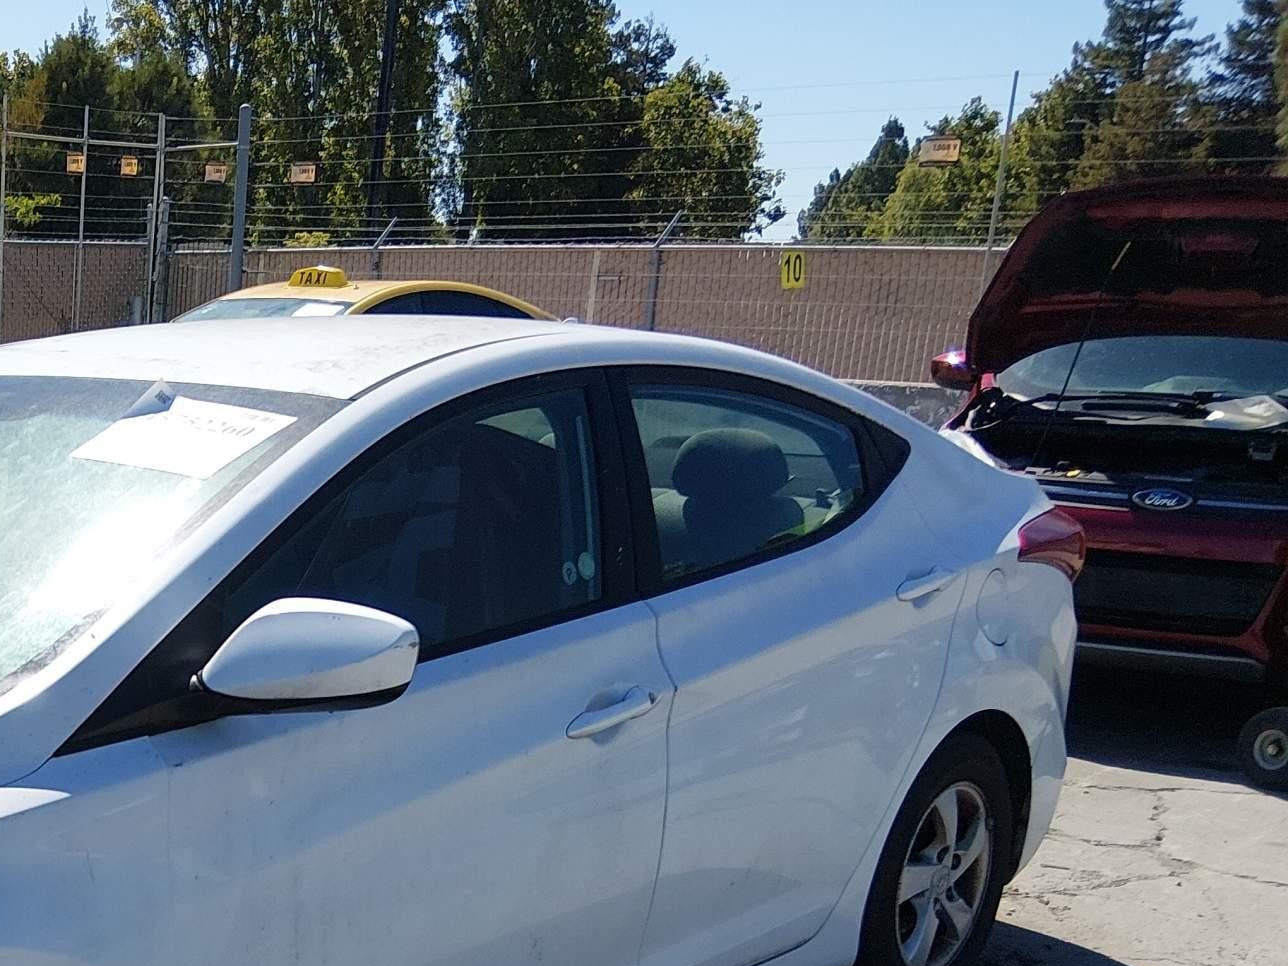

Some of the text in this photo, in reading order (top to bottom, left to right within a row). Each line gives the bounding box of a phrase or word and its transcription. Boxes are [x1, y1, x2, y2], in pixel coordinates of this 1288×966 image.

[784, 254, 802, 283] 10
[299, 271, 328, 285] TAXI
[1144, 493, 1180, 506] Ford
